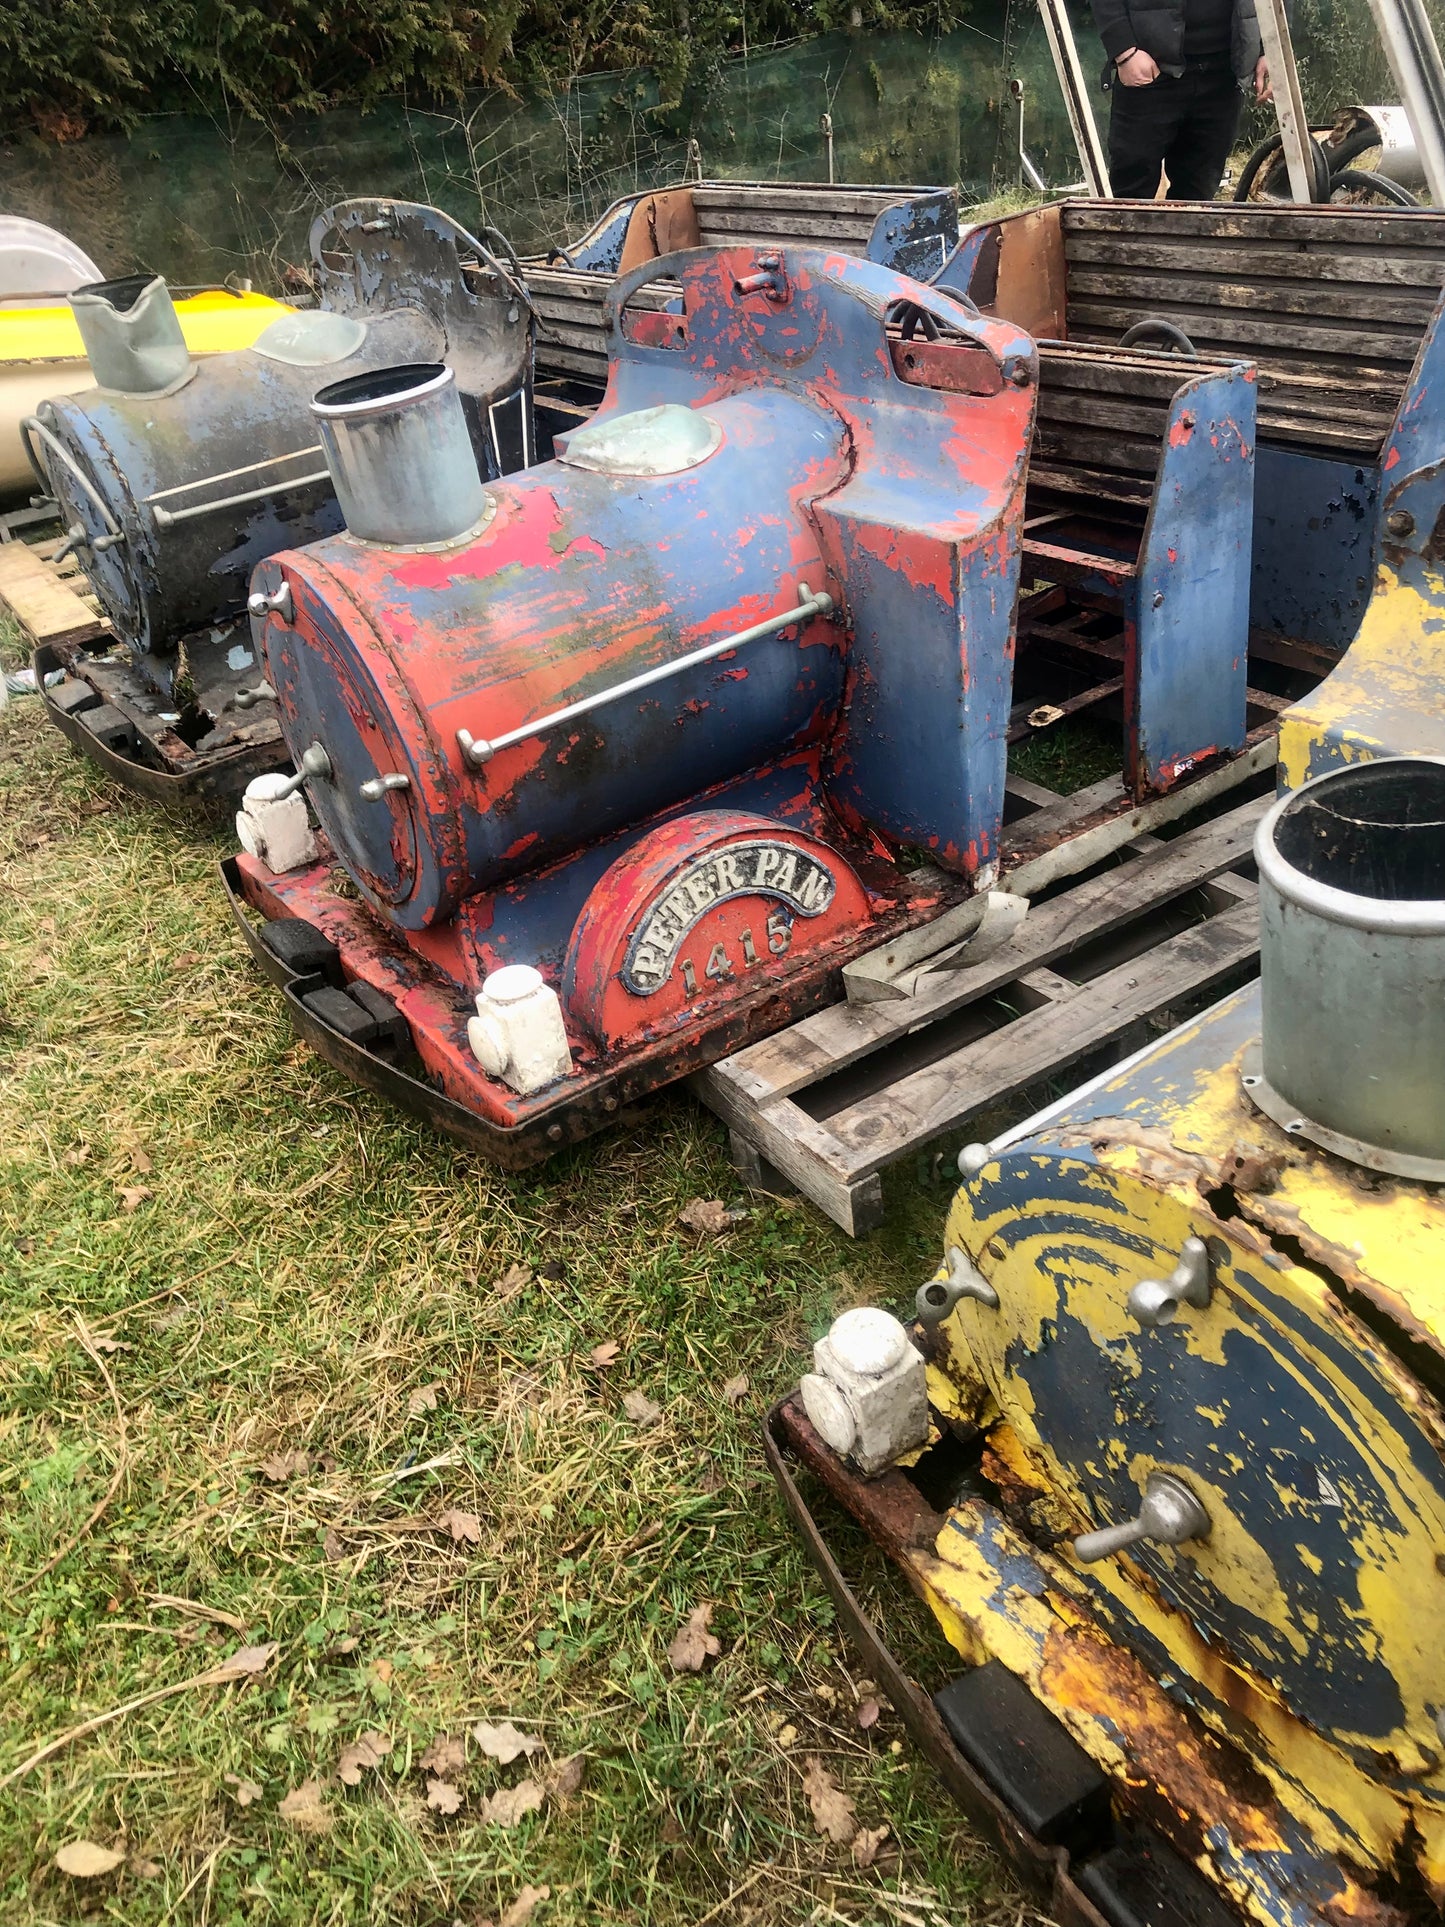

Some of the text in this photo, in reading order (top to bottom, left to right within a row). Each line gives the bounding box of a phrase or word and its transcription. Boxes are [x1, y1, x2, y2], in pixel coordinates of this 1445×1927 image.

[632, 847, 829, 977] PETER PAN
[679, 914, 793, 999] 1415
